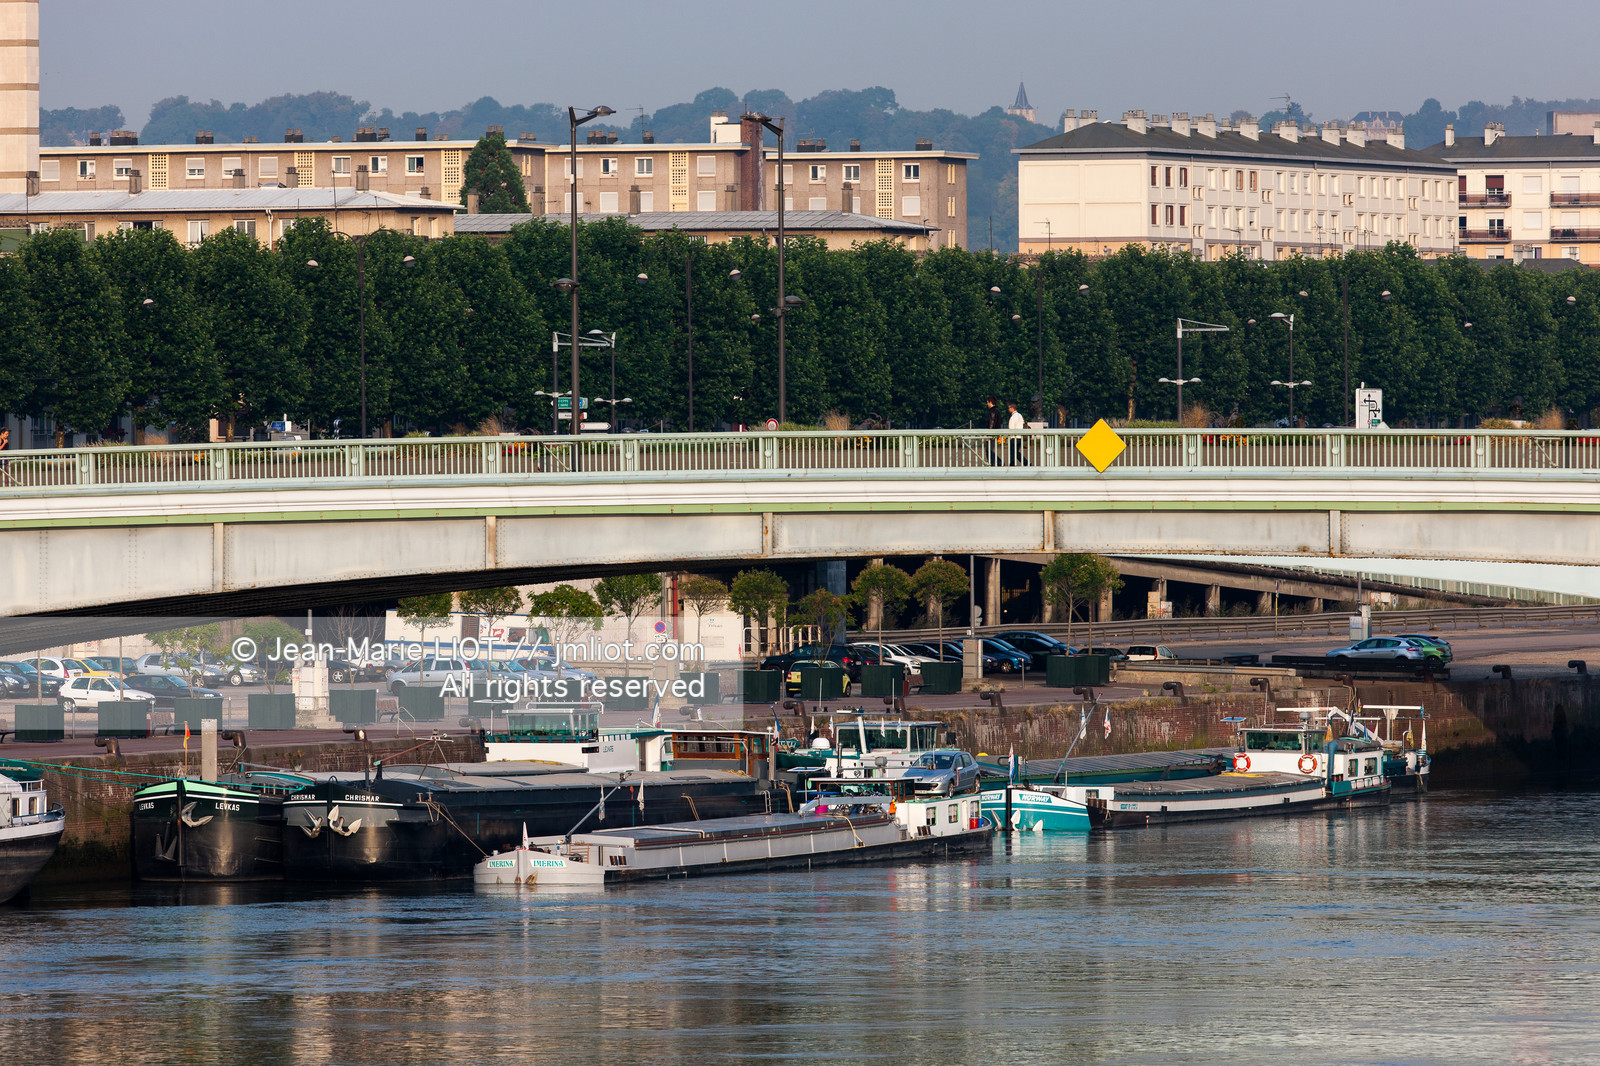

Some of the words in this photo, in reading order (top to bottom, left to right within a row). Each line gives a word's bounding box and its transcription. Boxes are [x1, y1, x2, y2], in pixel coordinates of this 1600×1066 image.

[344, 794, 380, 802] CHRISMAR
[1021, 794, 1050, 803] NORWAY
[215, 802, 240, 812] LEVKAS
[533, 860, 564, 868] IMERINA
